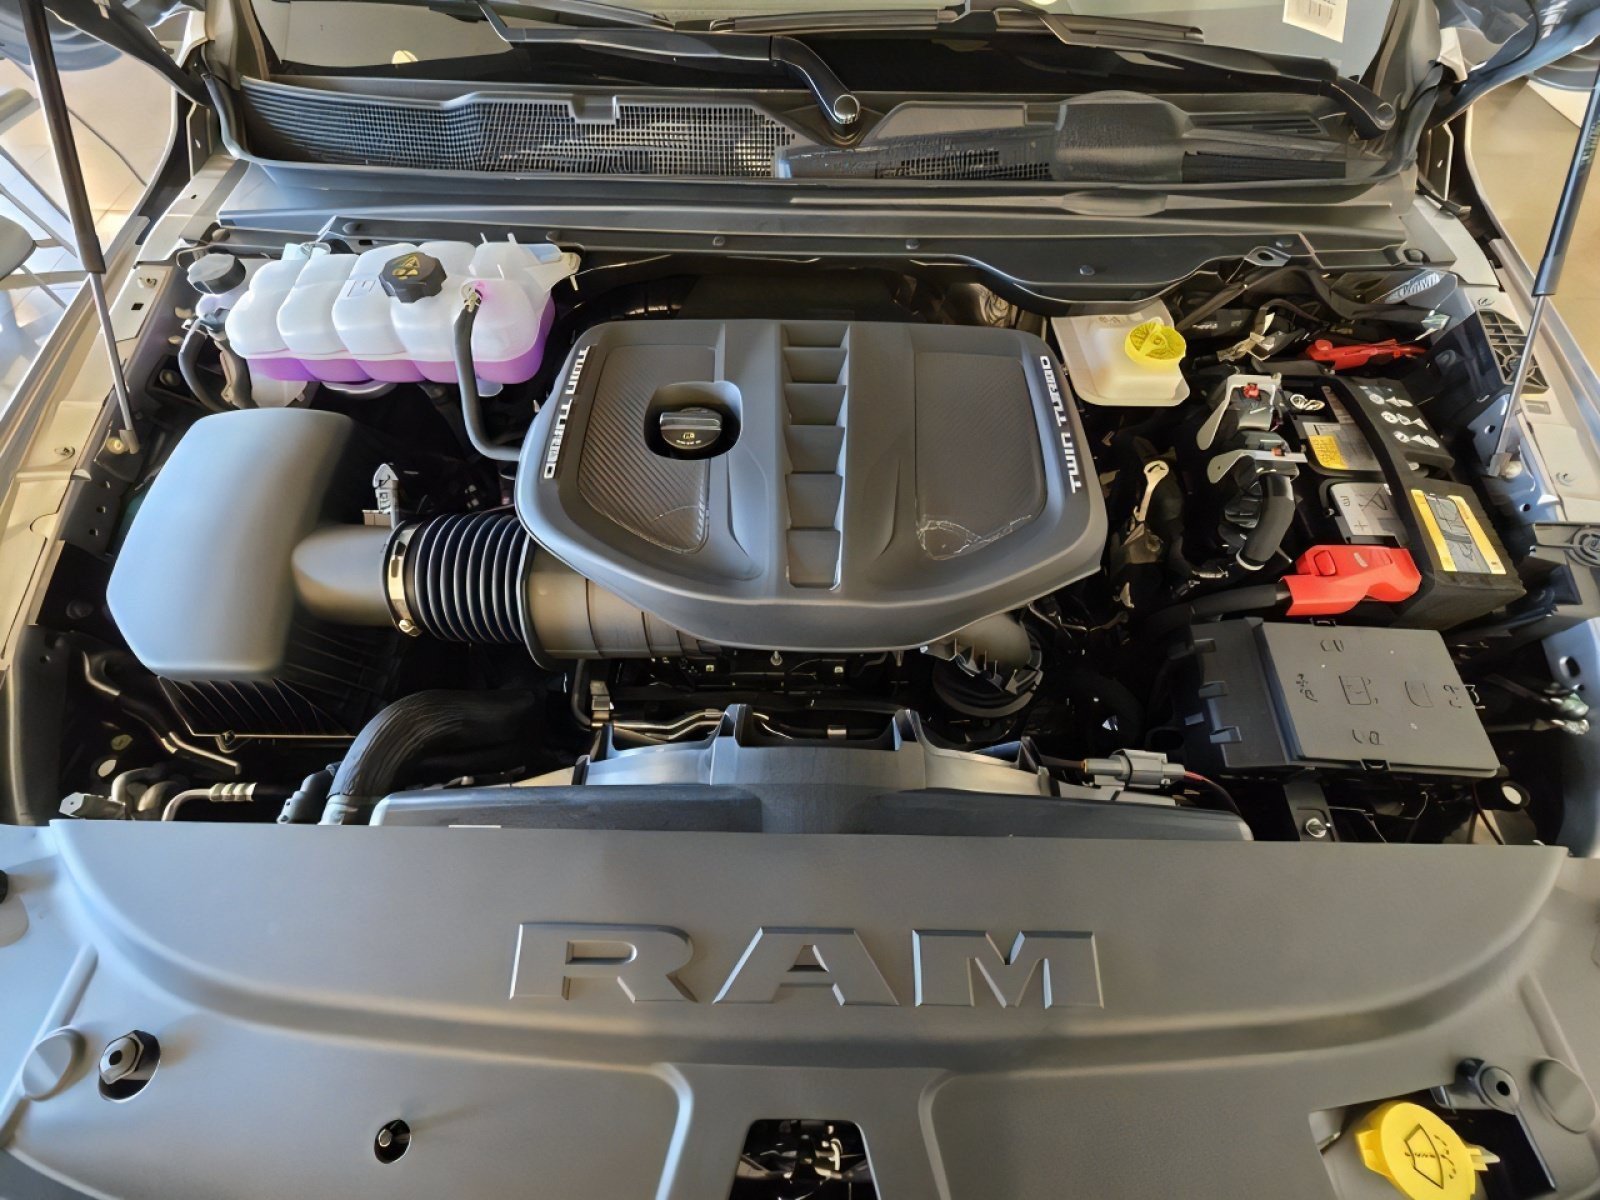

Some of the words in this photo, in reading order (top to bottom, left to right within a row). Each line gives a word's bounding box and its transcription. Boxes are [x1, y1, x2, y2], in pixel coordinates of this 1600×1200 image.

[565, 345, 591, 394] TWIN
[1040, 356, 1067, 427] TURBO
[1061, 432, 1082, 494] TWIN
[510, 922, 1104, 1008] RAM
